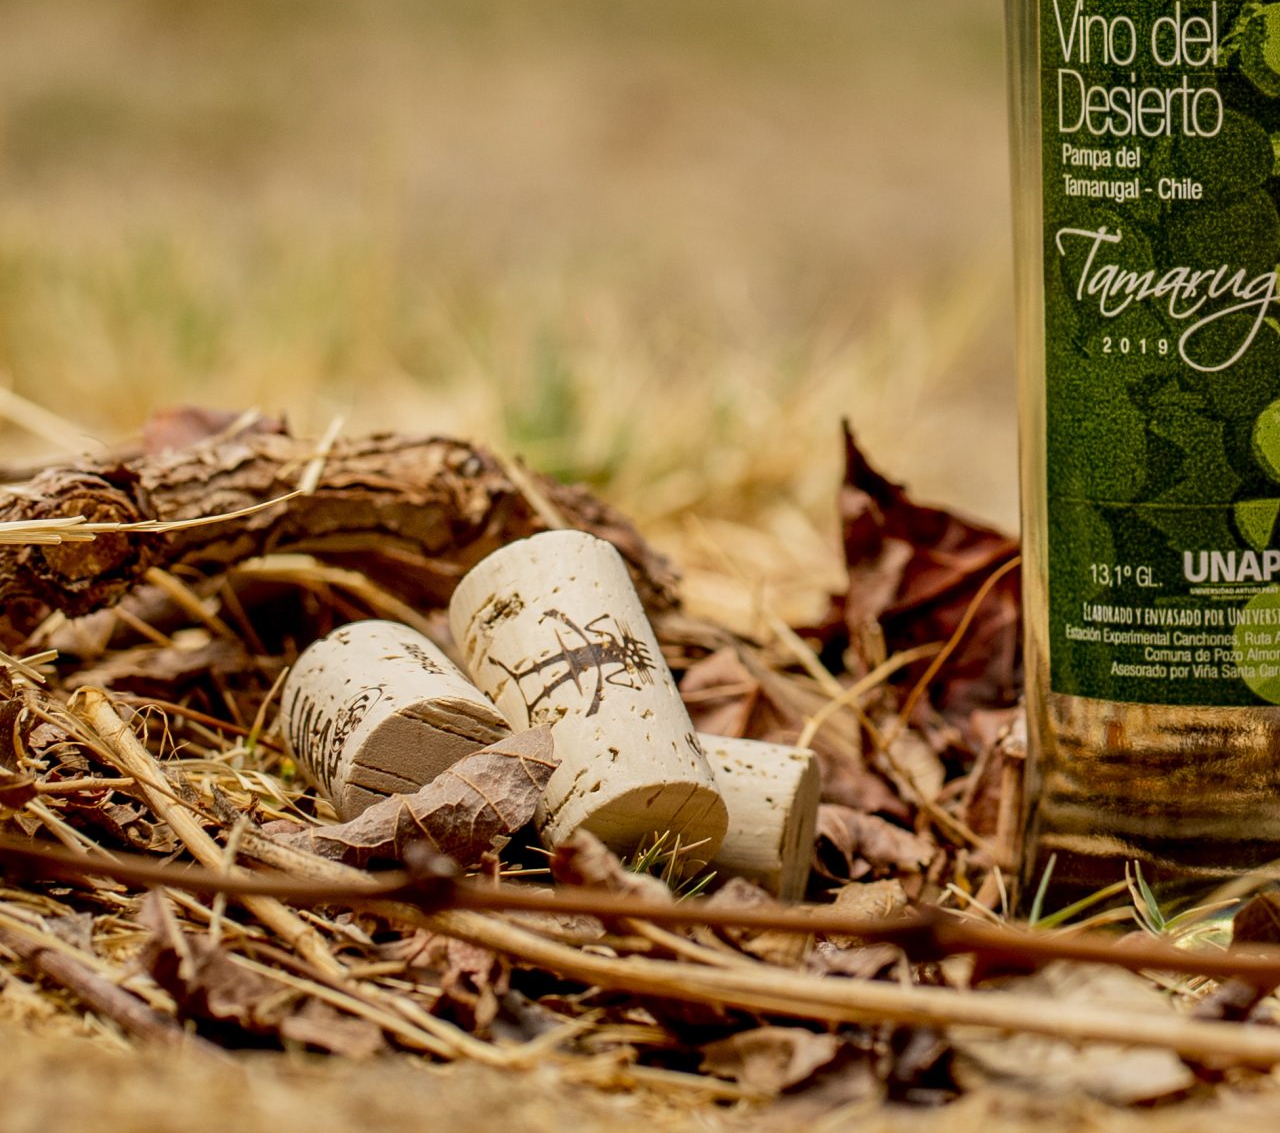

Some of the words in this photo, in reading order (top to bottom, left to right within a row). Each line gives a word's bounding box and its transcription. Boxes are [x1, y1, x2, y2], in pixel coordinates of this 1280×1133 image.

[1150, 0, 1218, 66] del
[1057, 68, 1224, 137] Desierto
[1061, 143, 1112, 170] Pampa
[1115, 146, 1141, 168] del
[1063, 174, 1140, 203] Tamarugal
[1157, 177, 1203, 200] Chile
[1135, 565, 1163, 588] GL.
[1082, 602, 1133, 625] ELABORADO
[1135, 608, 1142, 625] Y
[1144, 607, 1201, 627] ENVASADO
[1204, 608, 1225, 627] POR
[1065, 623, 1101, 642] Estación
[1103, 628, 1170, 646] Experimental
[1173, 631, 1240, 647] Canchones,
[1245, 632, 1272, 645] Ruta
[1144, 647, 1192, 662] Comuna
[1195, 648, 1211, 662] de
[1214, 648, 1244, 662] Pozo
[1111, 661, 1167, 678] Asesorado
[1170, 667, 1190, 680] por
[1193, 664, 1219, 679] Viña
[1221, 664, 1255, 678] Santa
